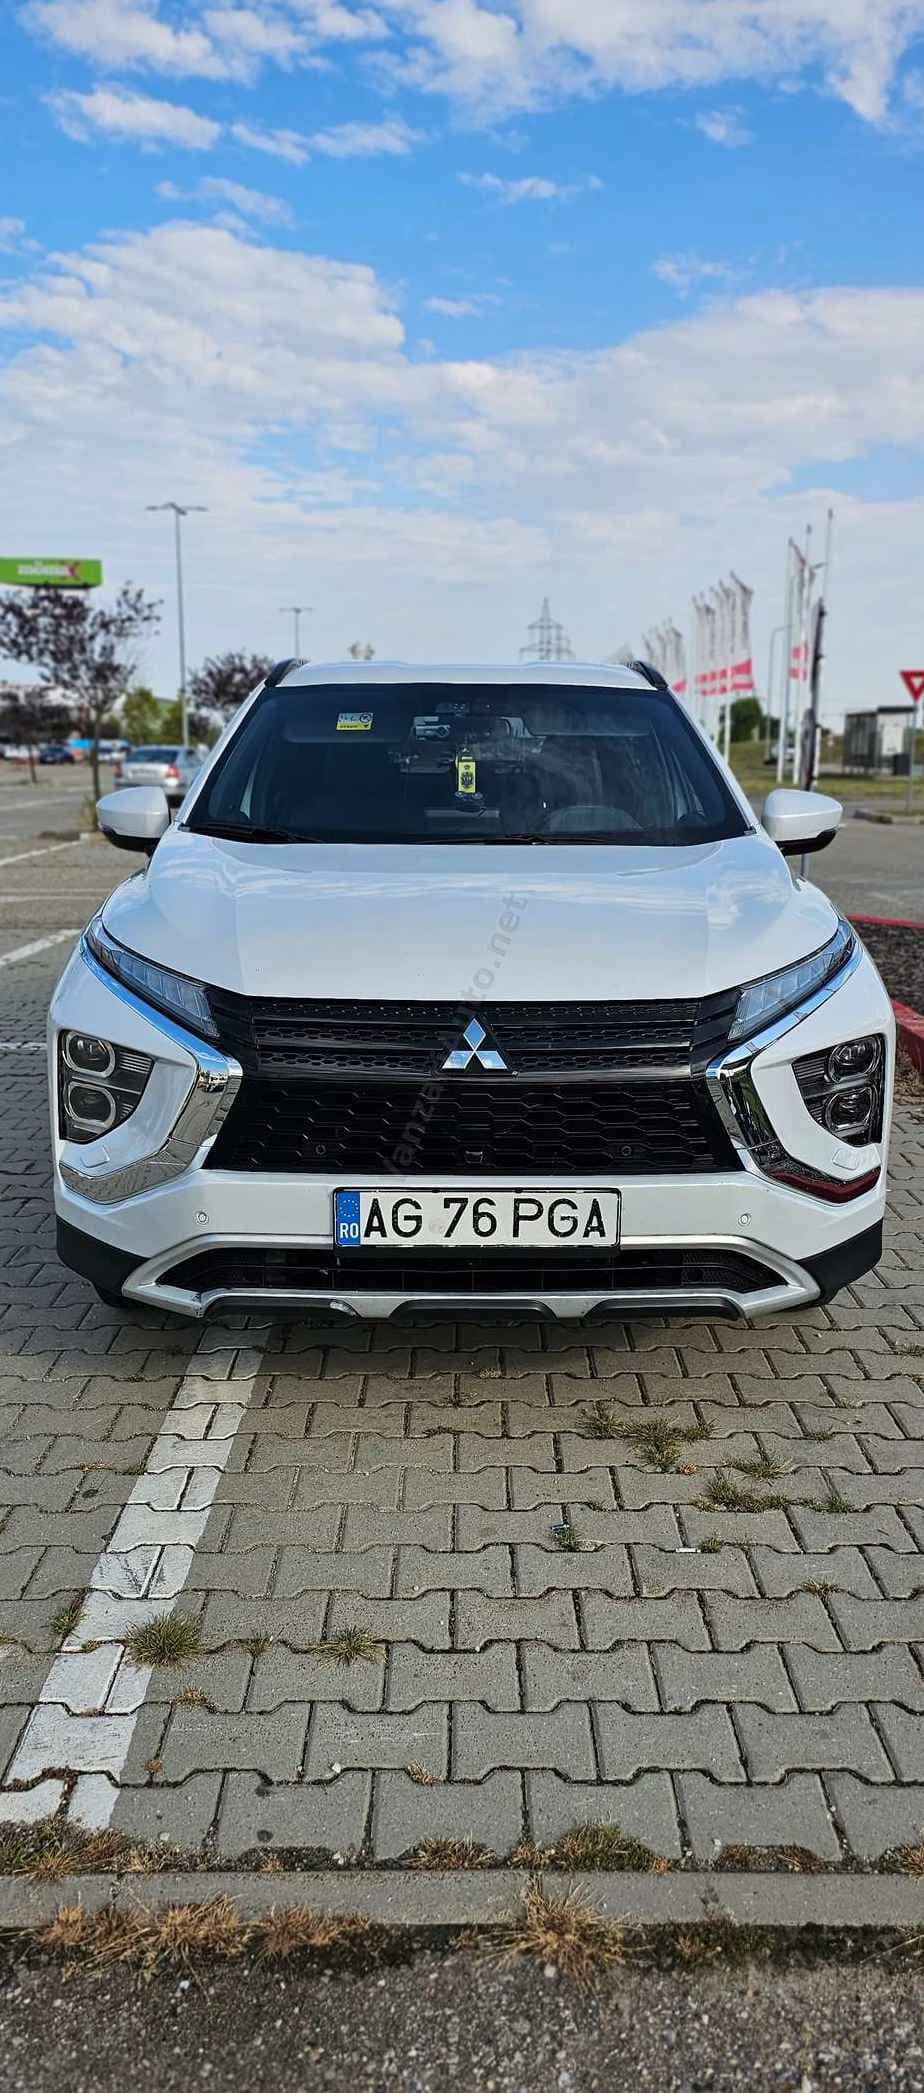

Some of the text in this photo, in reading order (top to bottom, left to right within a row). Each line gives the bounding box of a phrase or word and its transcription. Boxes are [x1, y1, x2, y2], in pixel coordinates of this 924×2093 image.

[339, 1223, 359, 1238] RO
[363, 1197, 606, 1238] AG 76 PGA
